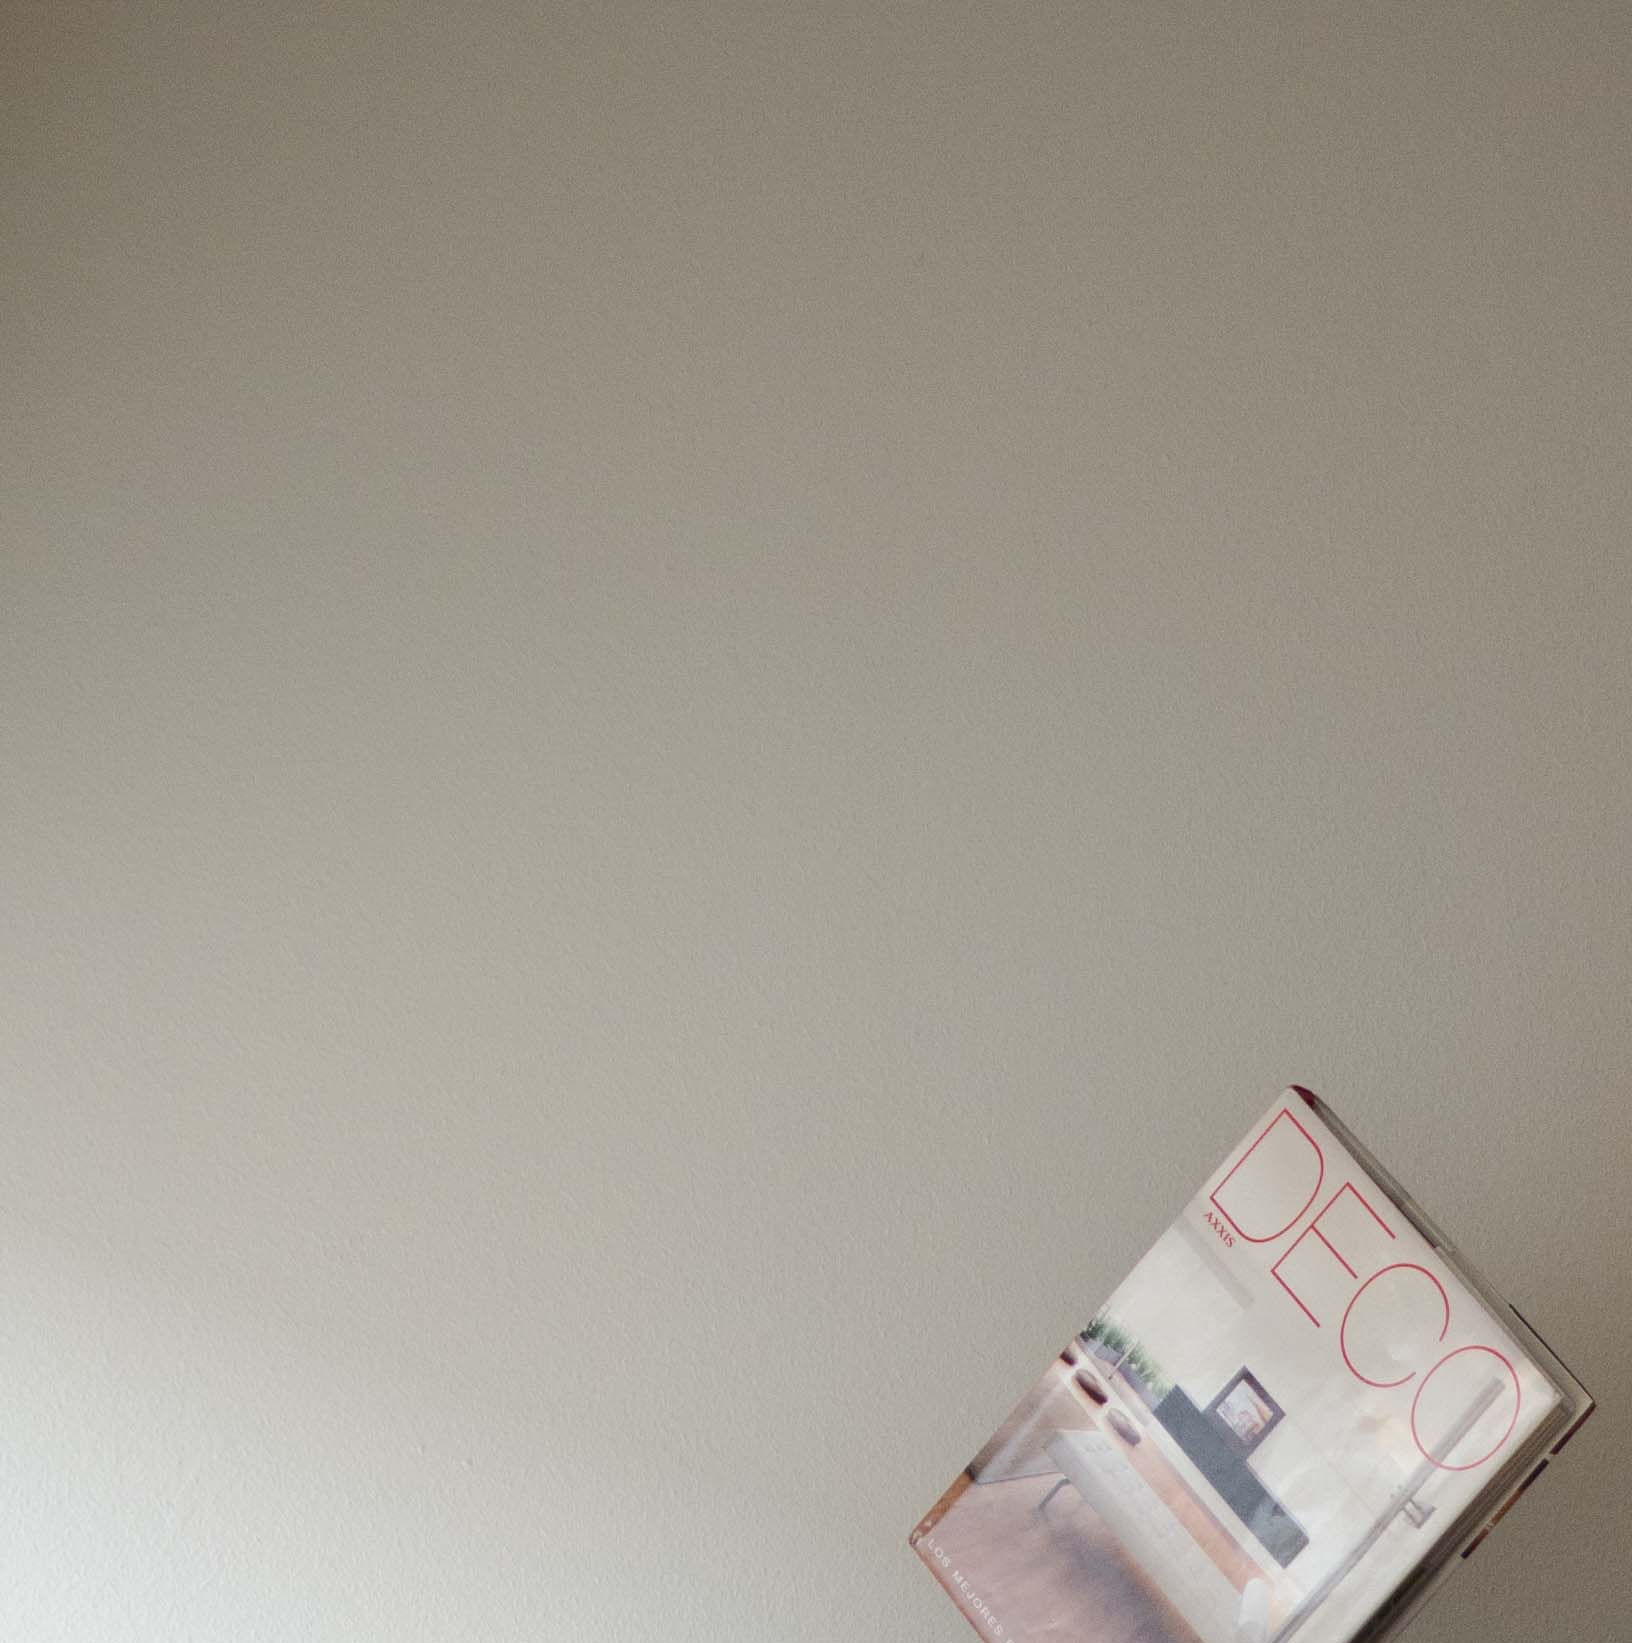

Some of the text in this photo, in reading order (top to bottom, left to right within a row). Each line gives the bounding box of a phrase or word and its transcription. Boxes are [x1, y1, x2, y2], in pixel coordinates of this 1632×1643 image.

[1203, 1212, 1236, 1248] AXXIS
[1209, 1108, 1521, 1471] DECO
[927, 1538, 951, 1568] LOS
[951, 1570, 1003, 1635] MEJORES
